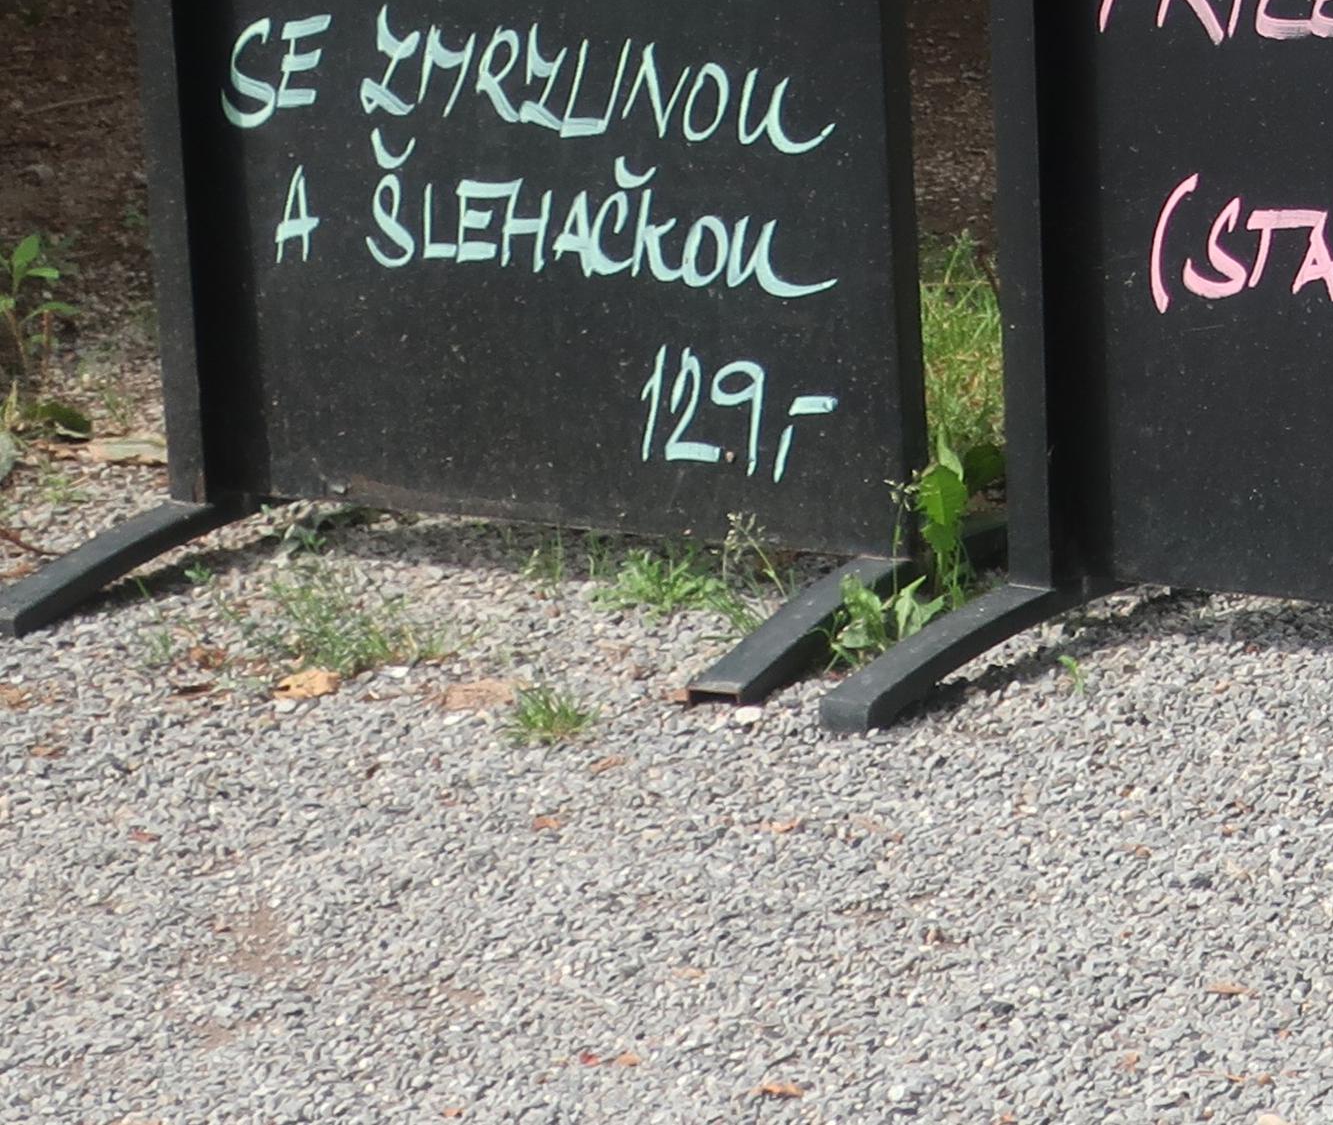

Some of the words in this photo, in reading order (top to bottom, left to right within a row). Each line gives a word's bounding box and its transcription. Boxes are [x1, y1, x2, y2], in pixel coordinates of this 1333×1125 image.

[221, 15, 331, 128] SE
[276, 167, 318, 262] A
[366, 129, 837, 297] ŠLEHAČKOU
